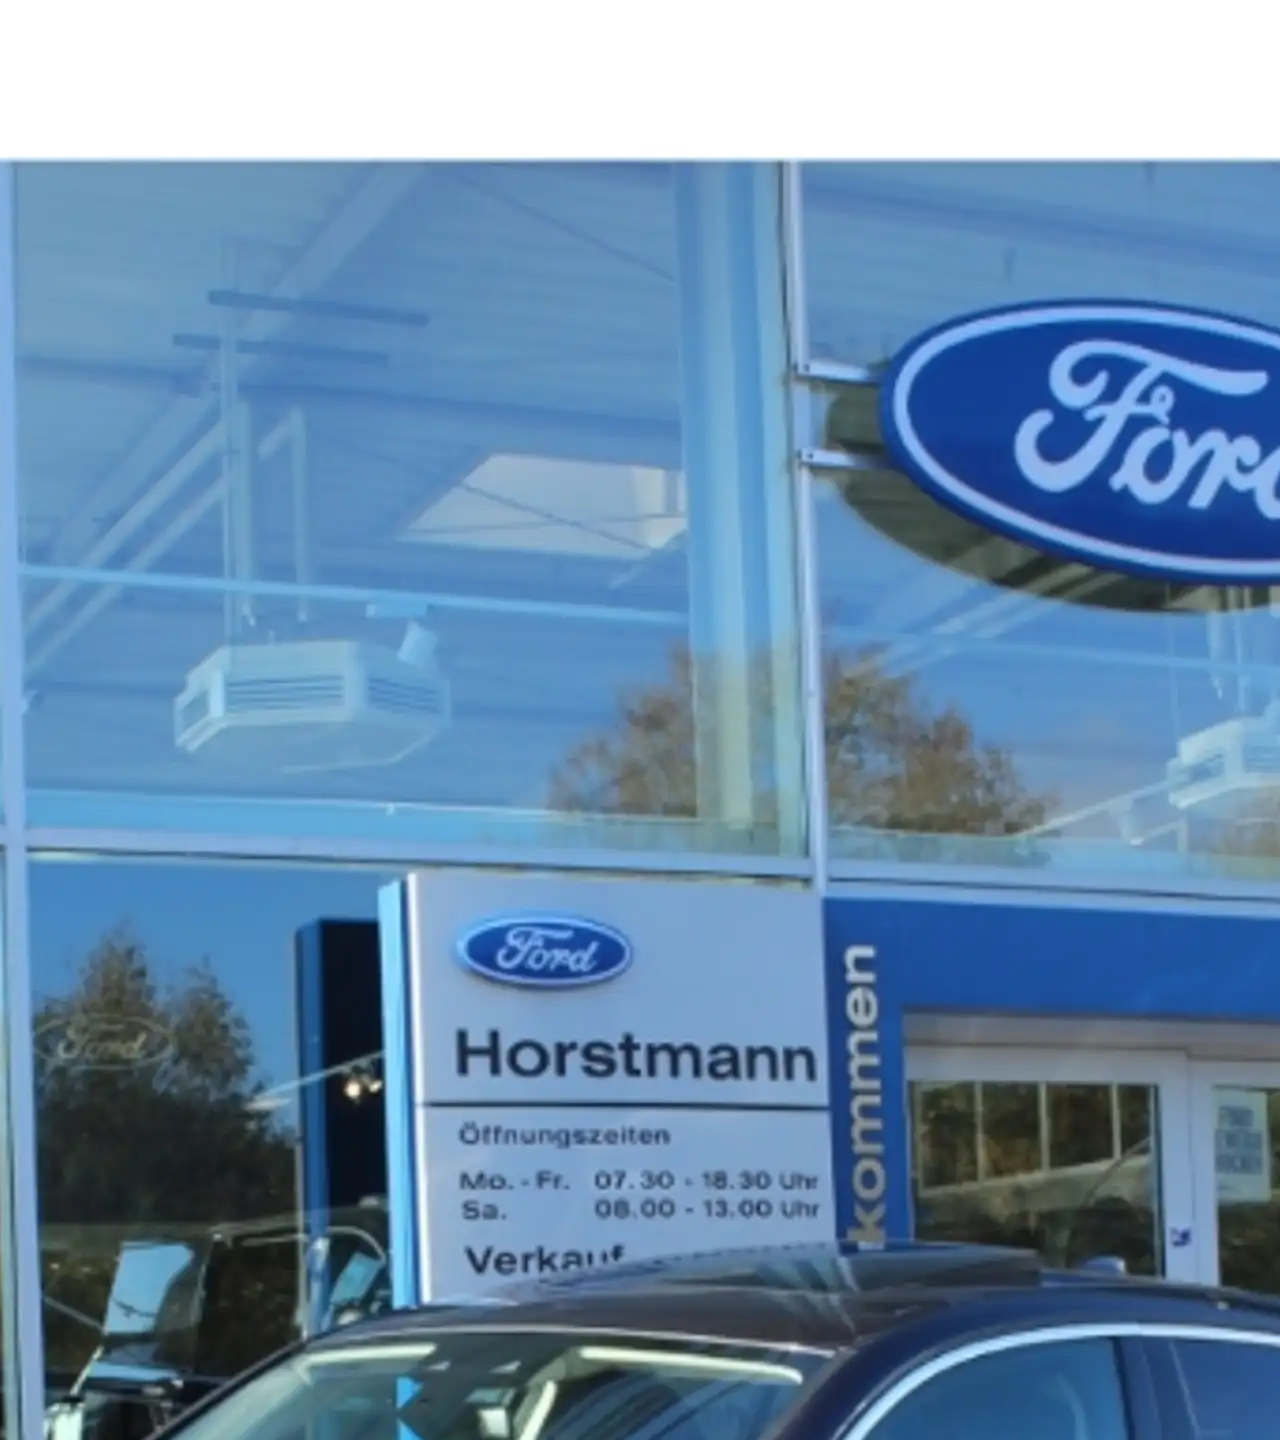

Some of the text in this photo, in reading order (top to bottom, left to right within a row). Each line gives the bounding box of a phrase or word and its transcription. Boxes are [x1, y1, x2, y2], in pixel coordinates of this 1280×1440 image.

[496, 926, 600, 972] Ford
[456, 1028, 818, 1082] Horstmann
[845, 945, 887, 1248] kommen
[458, 1121, 672, 1148] Öffnungszeiten
[458, 1171, 514, 1190] Mo.
[535, 1171, 570, 1190] Fr.
[594, 1170, 675, 1191] 07.30
[702, 1170, 771, 1190] 18.30
[779, 1171, 819, 1190] Uhr
[461, 1201, 507, 1220] Sa.
[594, 1200, 675, 1220] 08.00
[780, 1201, 820, 1219] Uhr
